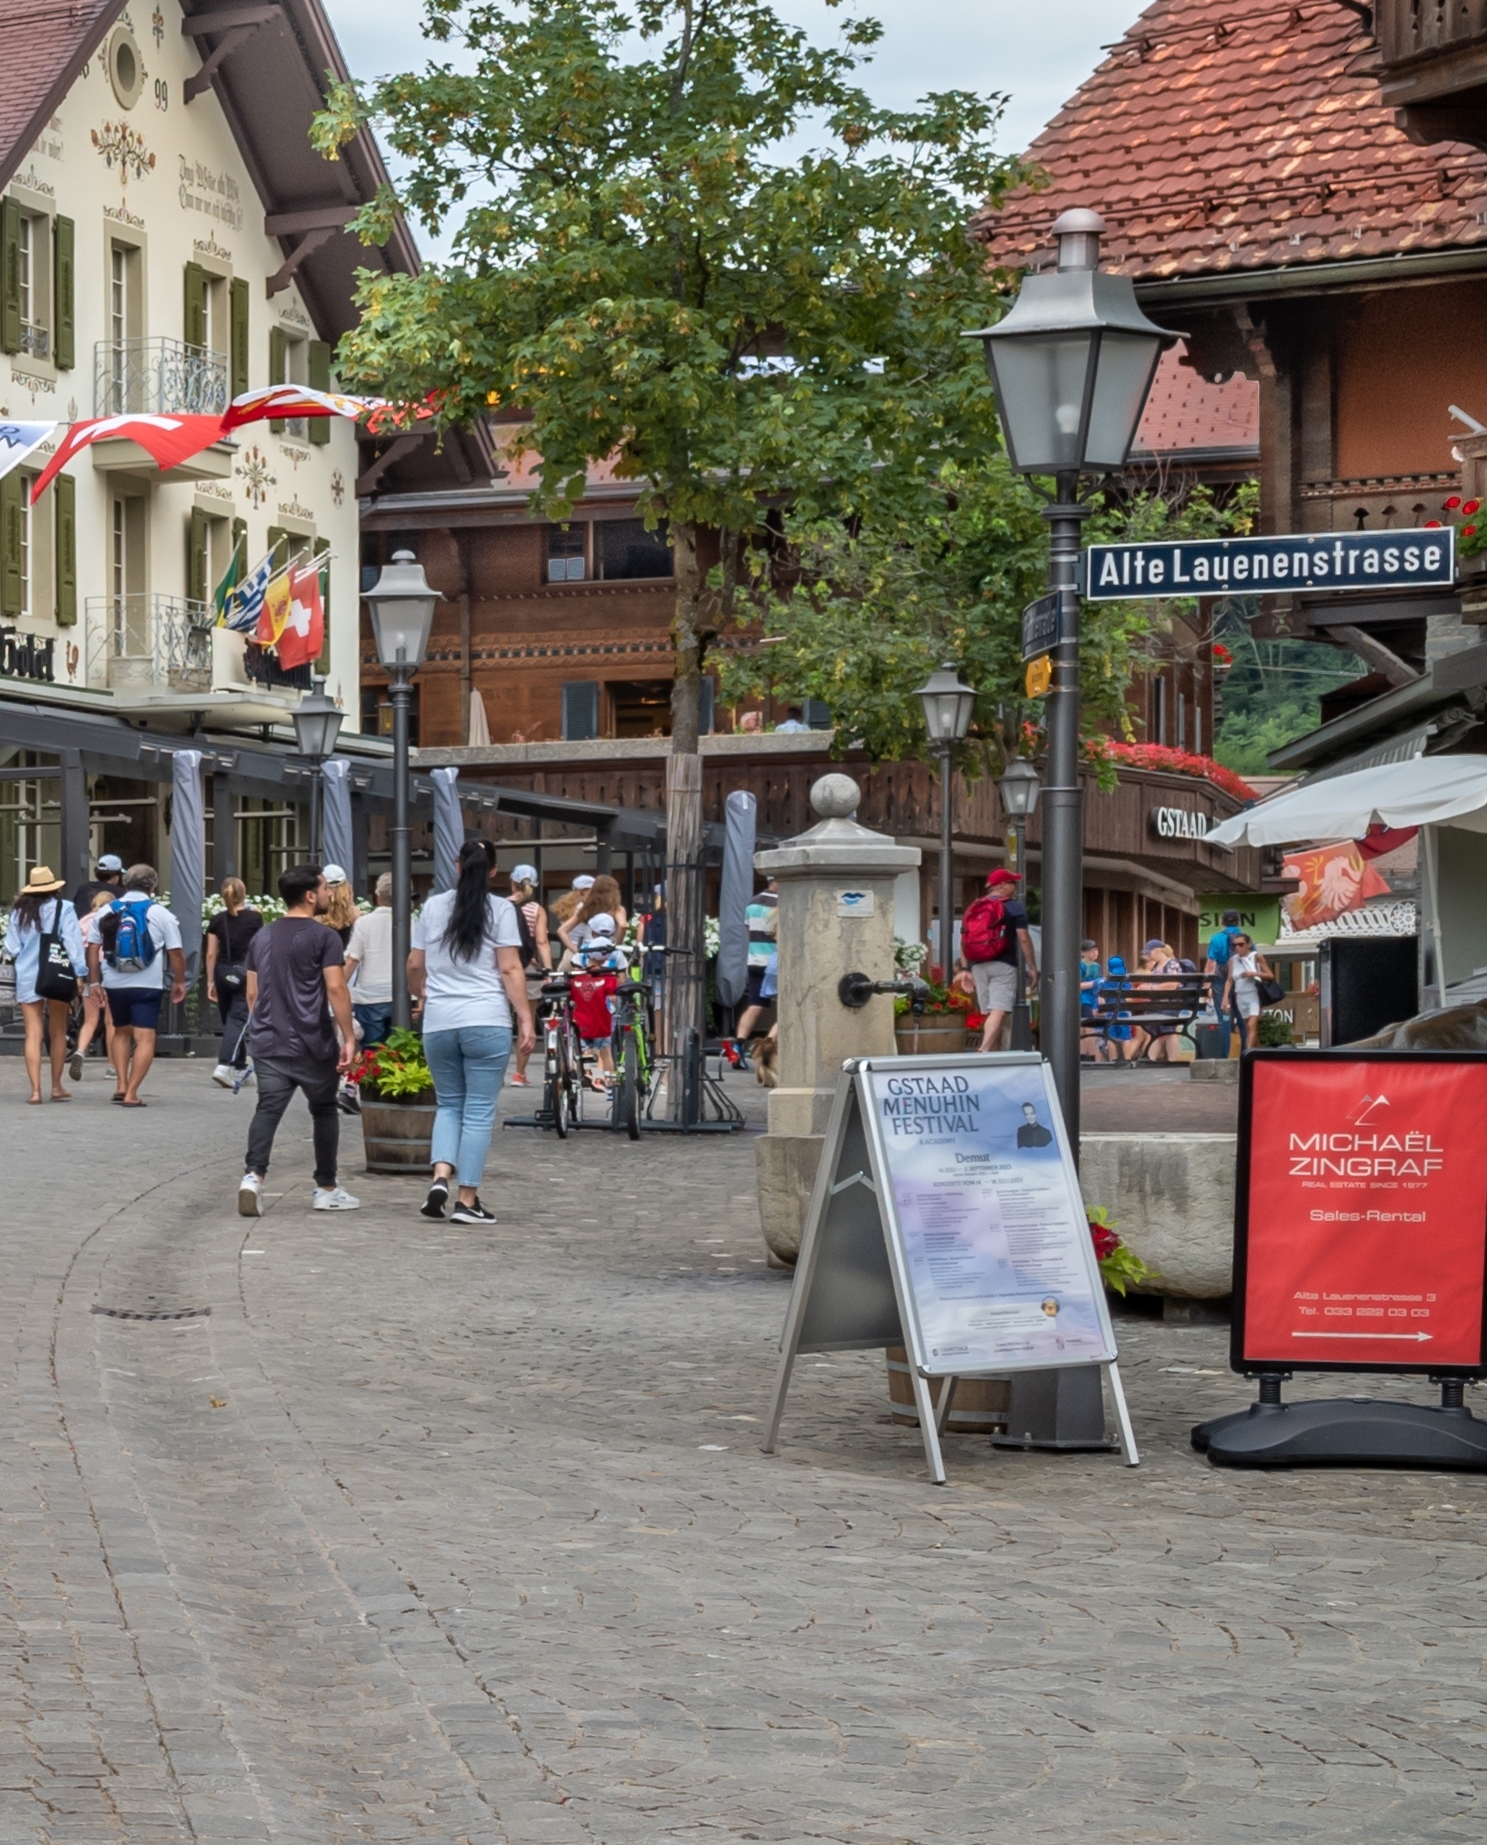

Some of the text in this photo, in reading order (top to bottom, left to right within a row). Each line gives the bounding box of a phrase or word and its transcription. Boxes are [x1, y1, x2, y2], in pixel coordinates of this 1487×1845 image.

[1099, 541, 1442, 587] Alte Lauenenstrasse
[1157, 806, 1207, 840] GSTAAD
[1199, 912, 1256, 928] SIN
[887, 1075, 969, 1096] GSTAAD
[883, 1094, 980, 1116] MENUHIN
[891, 1115, 979, 1135] FESTIVAL
[1288, 1130, 1444, 1153] MICHAËL
[955, 1152, 991, 1164] Demut
[1288, 1157, 1444, 1177] ZINGRAF
[1302, 1181, 1327, 1189] REAL
[1329, 1181, 1367, 1189] ESTATE
[1309, 1209, 1427, 1223] Sales-Rental
[1298, 1306, 1320, 1315] Tel.
